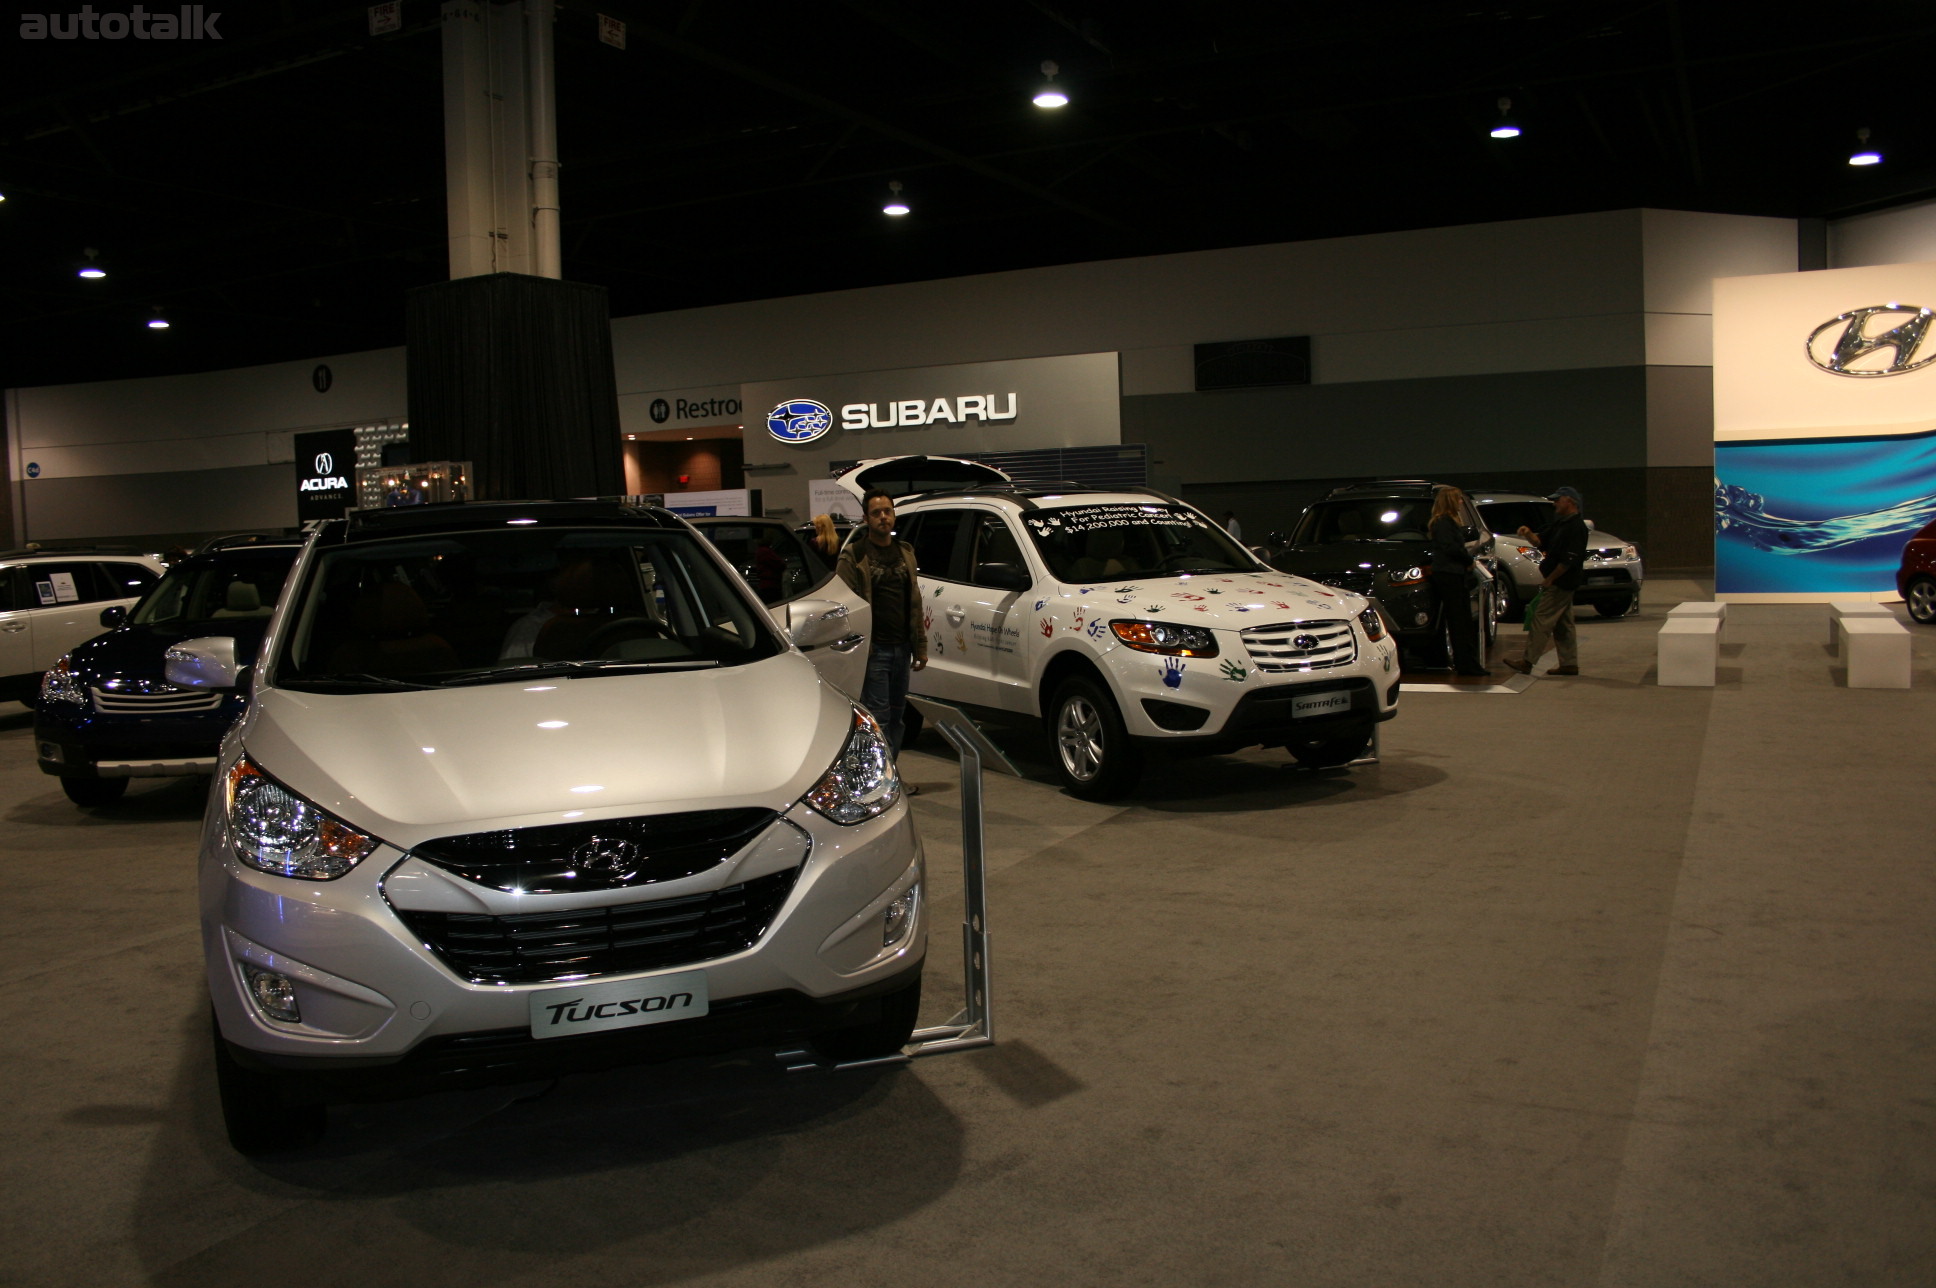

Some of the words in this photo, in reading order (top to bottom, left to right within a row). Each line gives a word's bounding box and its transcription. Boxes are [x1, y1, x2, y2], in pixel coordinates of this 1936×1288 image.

[676, 397, 742, 419] Restro
[841, 392, 1018, 430] SUBARU
[300, 476, 348, 491] ACURA
[1060, 506, 1102, 518] Hyundai
[1101, 505, 1138, 513] Raising
[1071, 515, 1090, 523] For
[1090, 511, 1138, 521] Pediatric
[970, 621, 986, 631] Hyundai
